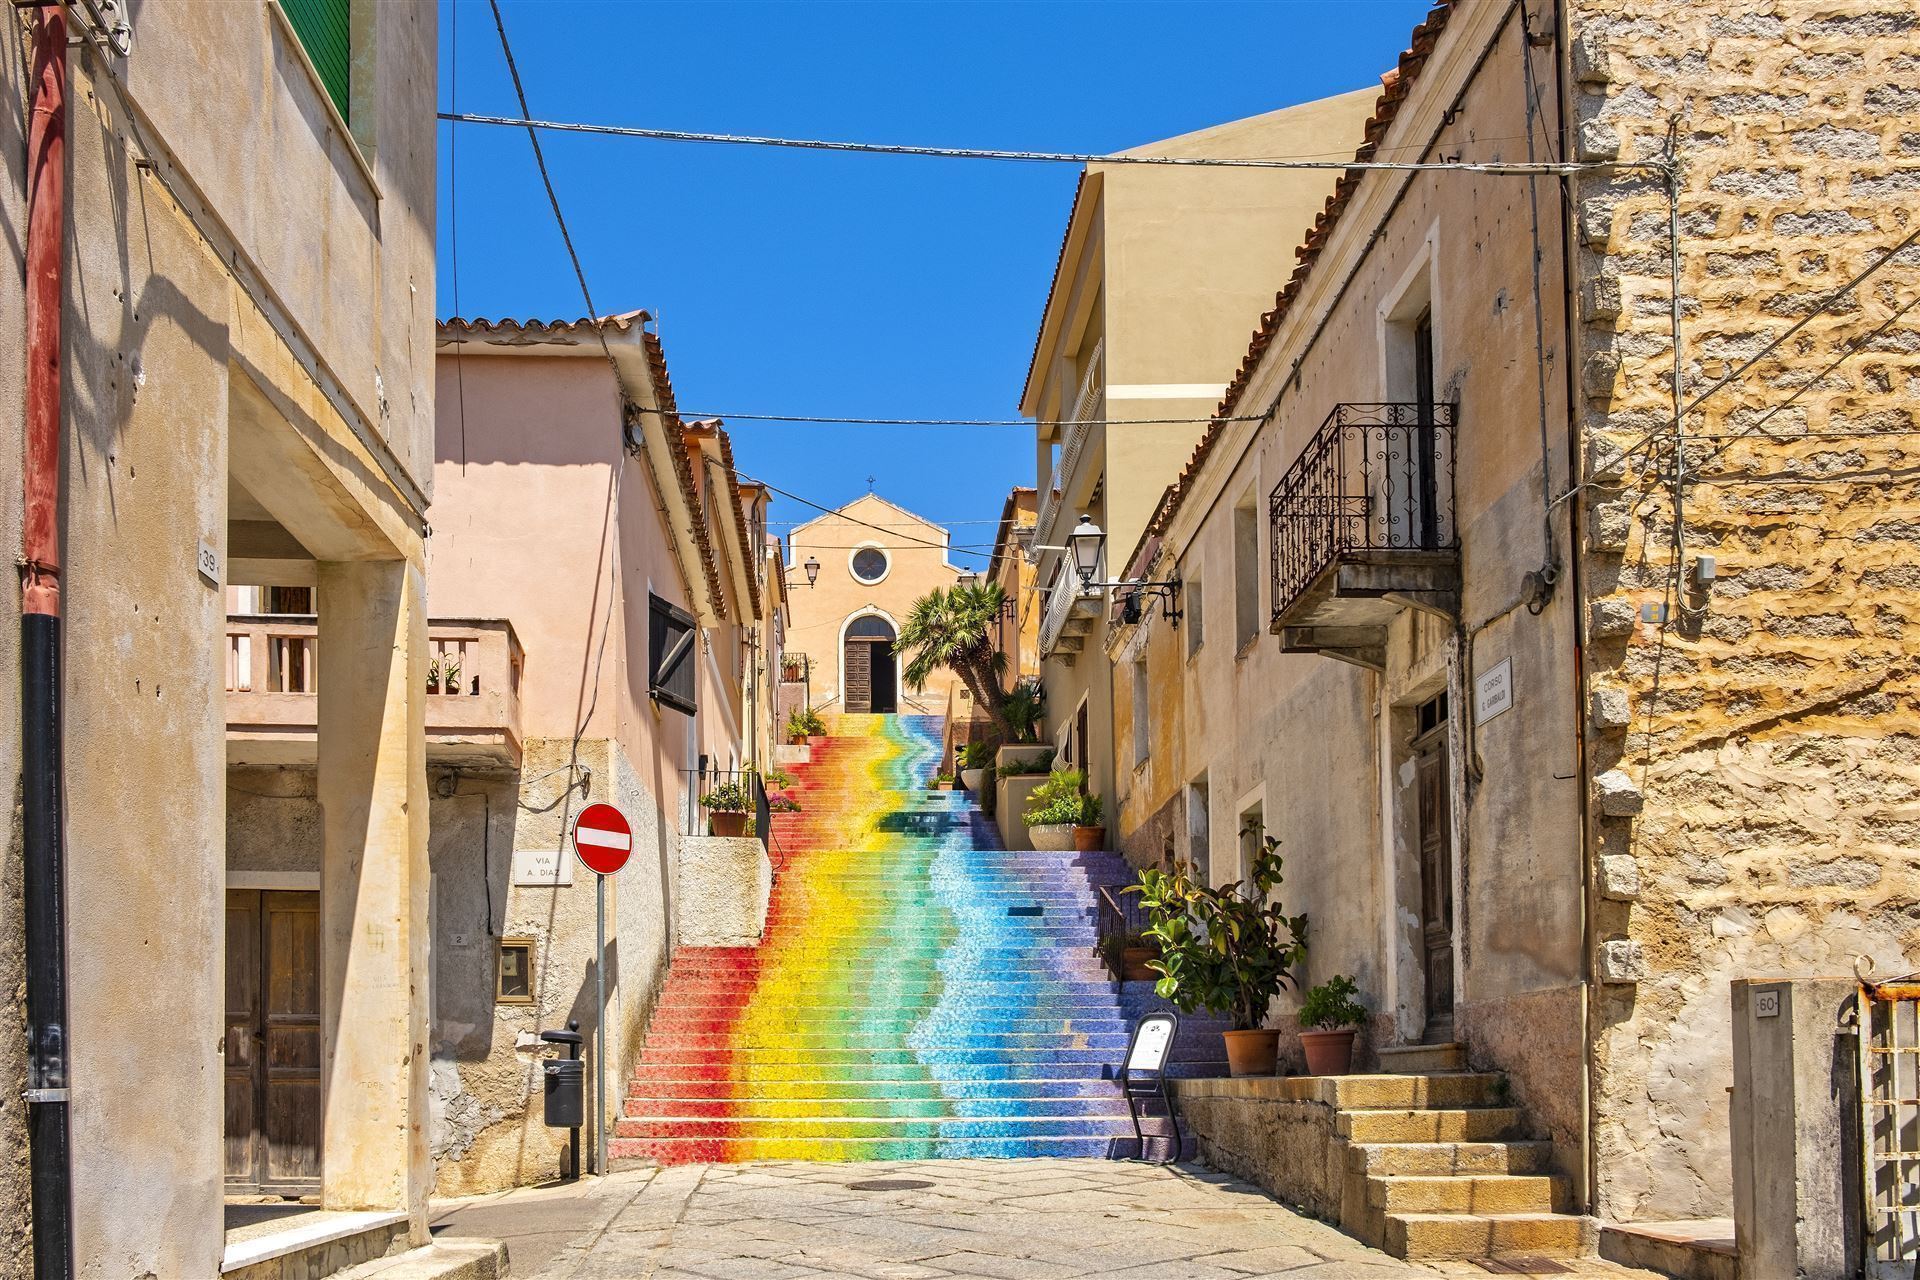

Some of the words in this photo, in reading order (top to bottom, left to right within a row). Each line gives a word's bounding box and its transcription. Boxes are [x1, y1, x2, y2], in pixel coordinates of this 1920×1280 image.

[1483, 673, 1503, 693] CORSO
[540, 869, 560, 877] DIAZ
[456, 935, 462, 944] 2
